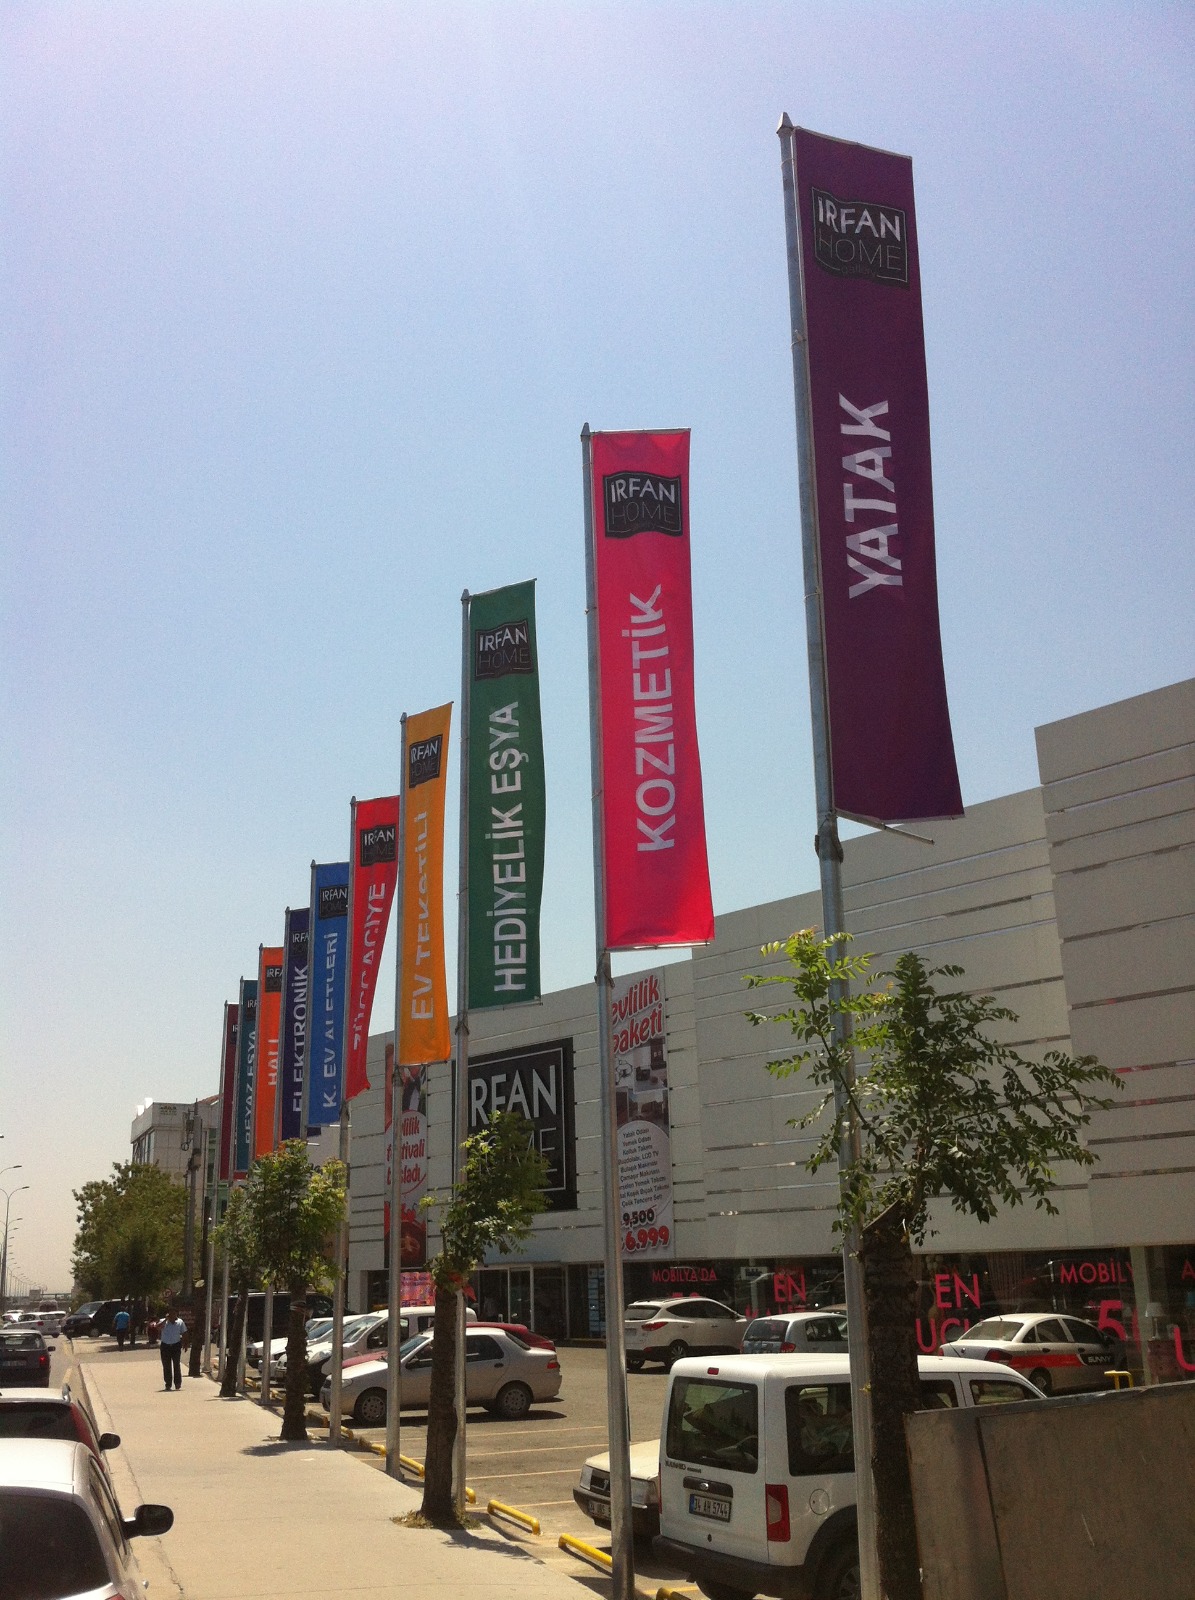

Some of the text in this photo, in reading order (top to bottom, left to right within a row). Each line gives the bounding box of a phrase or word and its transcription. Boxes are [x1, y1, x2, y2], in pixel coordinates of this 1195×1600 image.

[819, 230, 902, 270] HOME
[612, 502, 675, 525] HOME
[838, 392, 903, 599] YATAK
[480, 648, 529, 668] HOME
[622, 584, 676, 851] KOZMETİK
[488, 701, 529, 795] EŞYA
[485, 802, 527, 992] HEDİYELİK
[293, 932, 310, 943] IRFA
[411, 974, 434, 1020] EV
[323, 1047, 337, 1079] EV
[471, 1065, 557, 1127] RFAN
[773, 1273, 807, 1302] EN
[934, 1273, 981, 1309] EN
